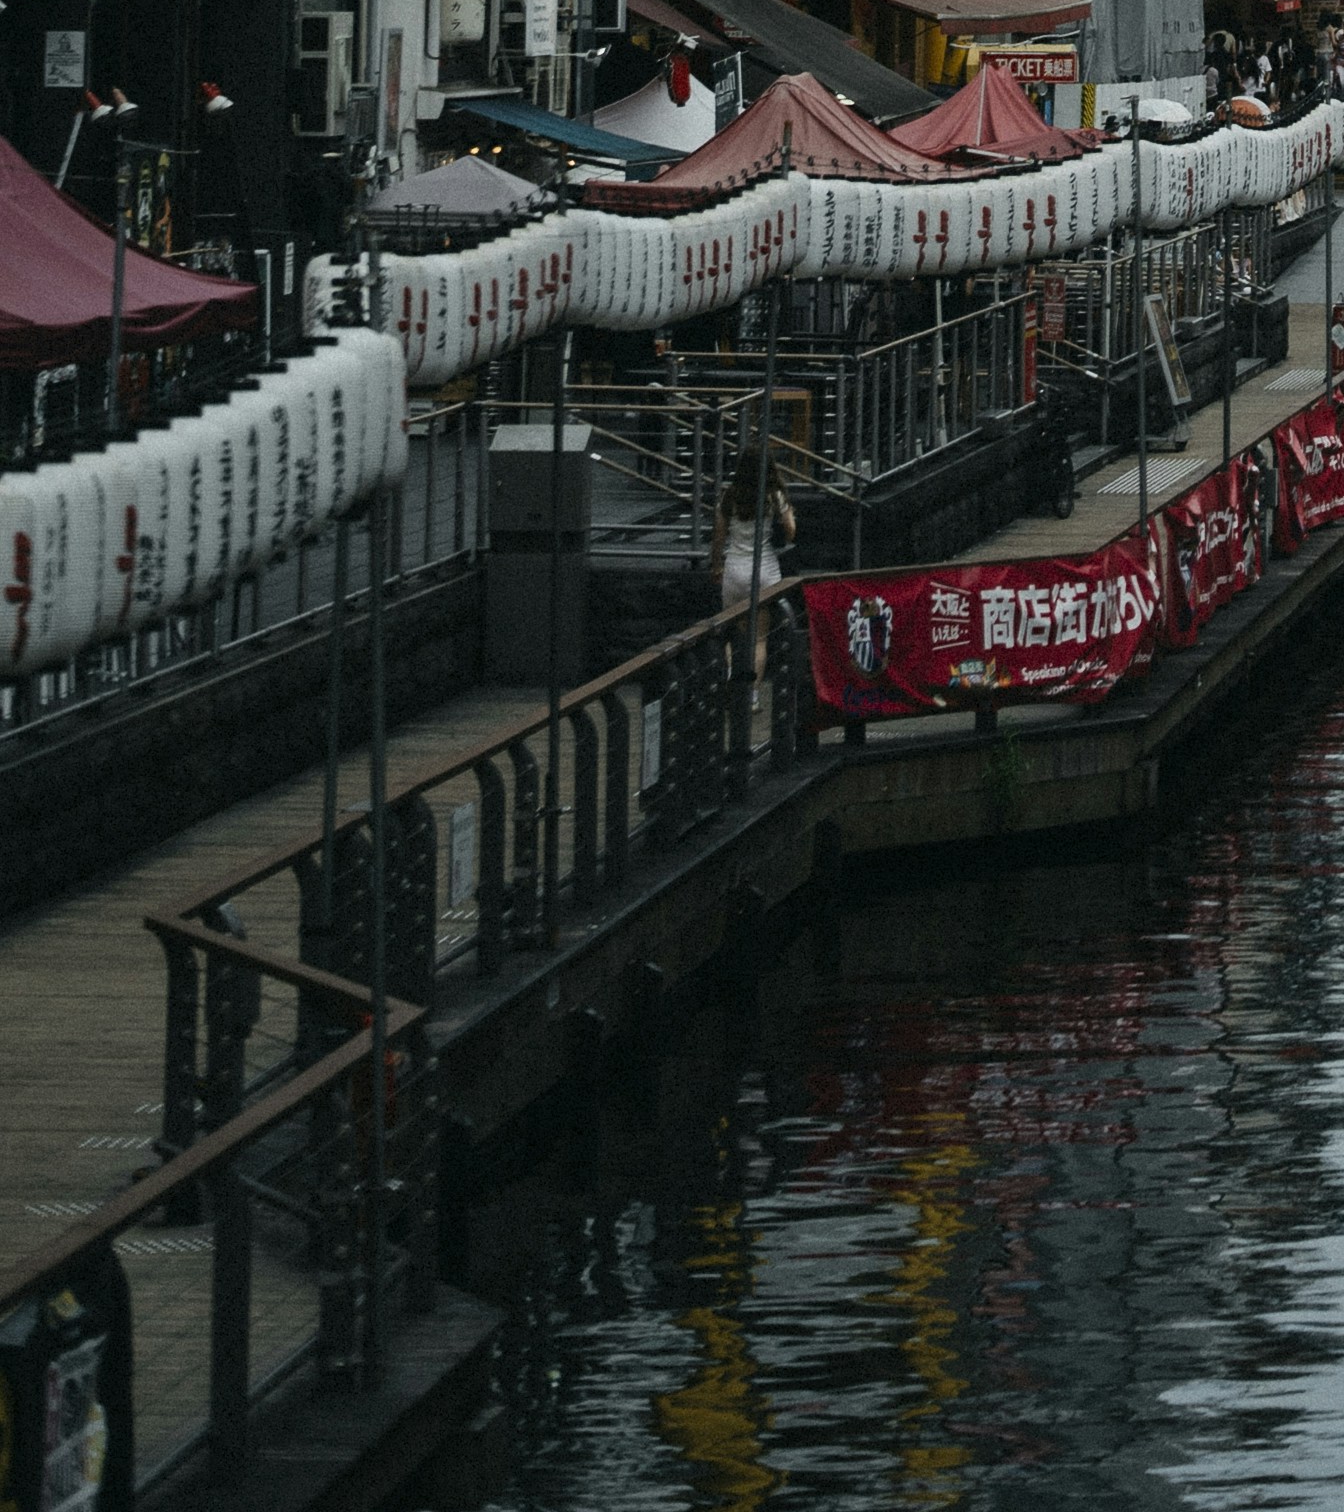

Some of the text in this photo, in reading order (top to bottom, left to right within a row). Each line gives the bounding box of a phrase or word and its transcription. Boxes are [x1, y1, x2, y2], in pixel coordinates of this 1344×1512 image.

[1044, 57, 1074, 77] 乗船票
[932, 590, 971, 619] 大阪と
